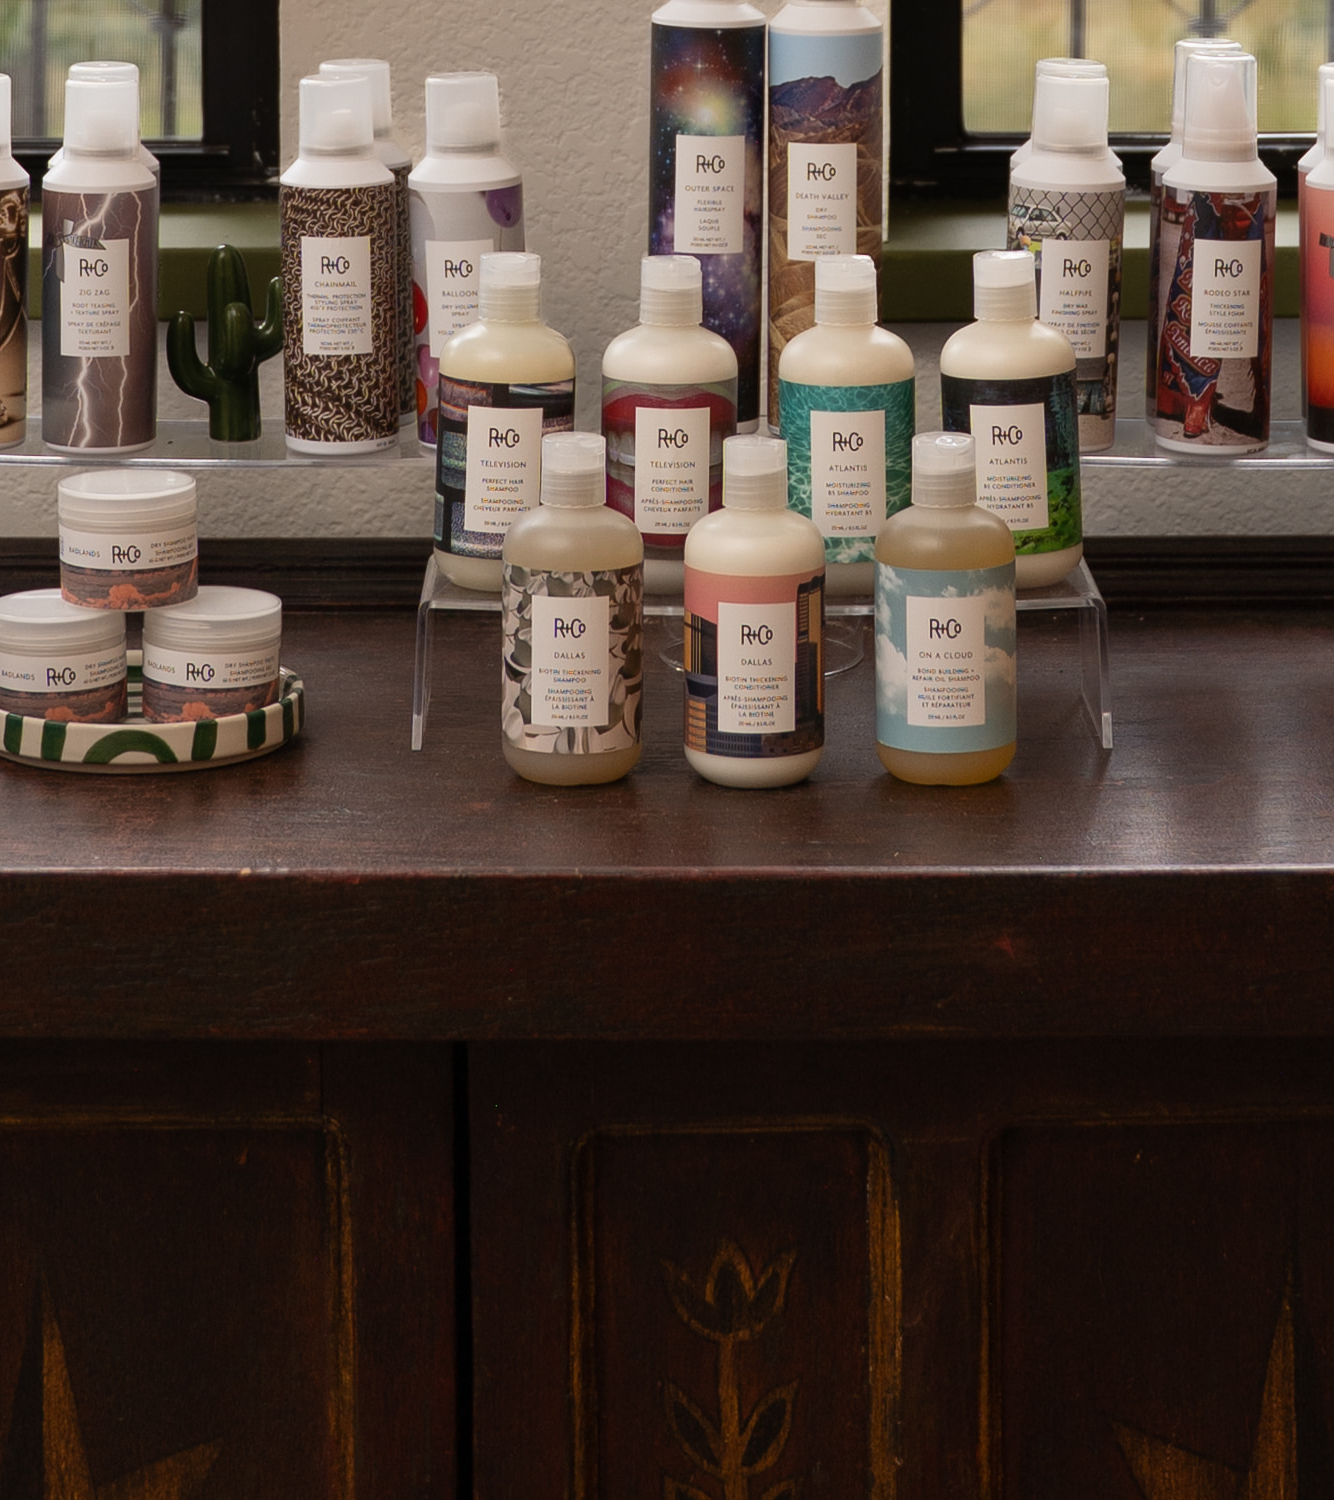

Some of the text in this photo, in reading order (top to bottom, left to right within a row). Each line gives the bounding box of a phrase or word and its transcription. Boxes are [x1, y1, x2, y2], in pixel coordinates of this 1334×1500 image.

[696, 154, 725, 174] R+Co
[807, 162, 836, 181] R+Co
[685, 184, 735, 192] OUTER SPACE
[795, 192, 850, 200] DEATH VALLEY
[79, 258, 108, 277] R+Co
[321, 256, 350, 274] R+Co
[444, 260, 473, 278] R+Co
[1063, 259, 1091, 278] R+Co
[1214, 259, 1243, 277] R+Co
[489, 428, 520, 448] R+Co
[658, 429, 688, 448] R+Co
[833, 432, 863, 452] R+Co
[992, 426, 1023, 445] R+Co
[480, 460, 527, 469] TELEVISION
[650, 460, 696, 469] TELEVISION
[829, 464, 868, 473] ATLANTIS
[988, 457, 1028, 466] ATLANTIS
[69, 546, 100, 558] BADLANDS
[112, 545, 141, 564] R+Co
[554, 618, 586, 638] R+Co
[741, 624, 773, 645] R+Co
[930, 618, 962, 639] R+Co
[554, 651, 586, 660] DALLAS
[740, 658, 773, 666] DALLAS
[919, 651, 973, 660] ON A CLOUD
[2, 670, 35, 681] BADLANDS
[148, 659, 176, 674] BADLANDS
[186, 663, 215, 682] R+Co
[47, 667, 76, 687] R+Co
